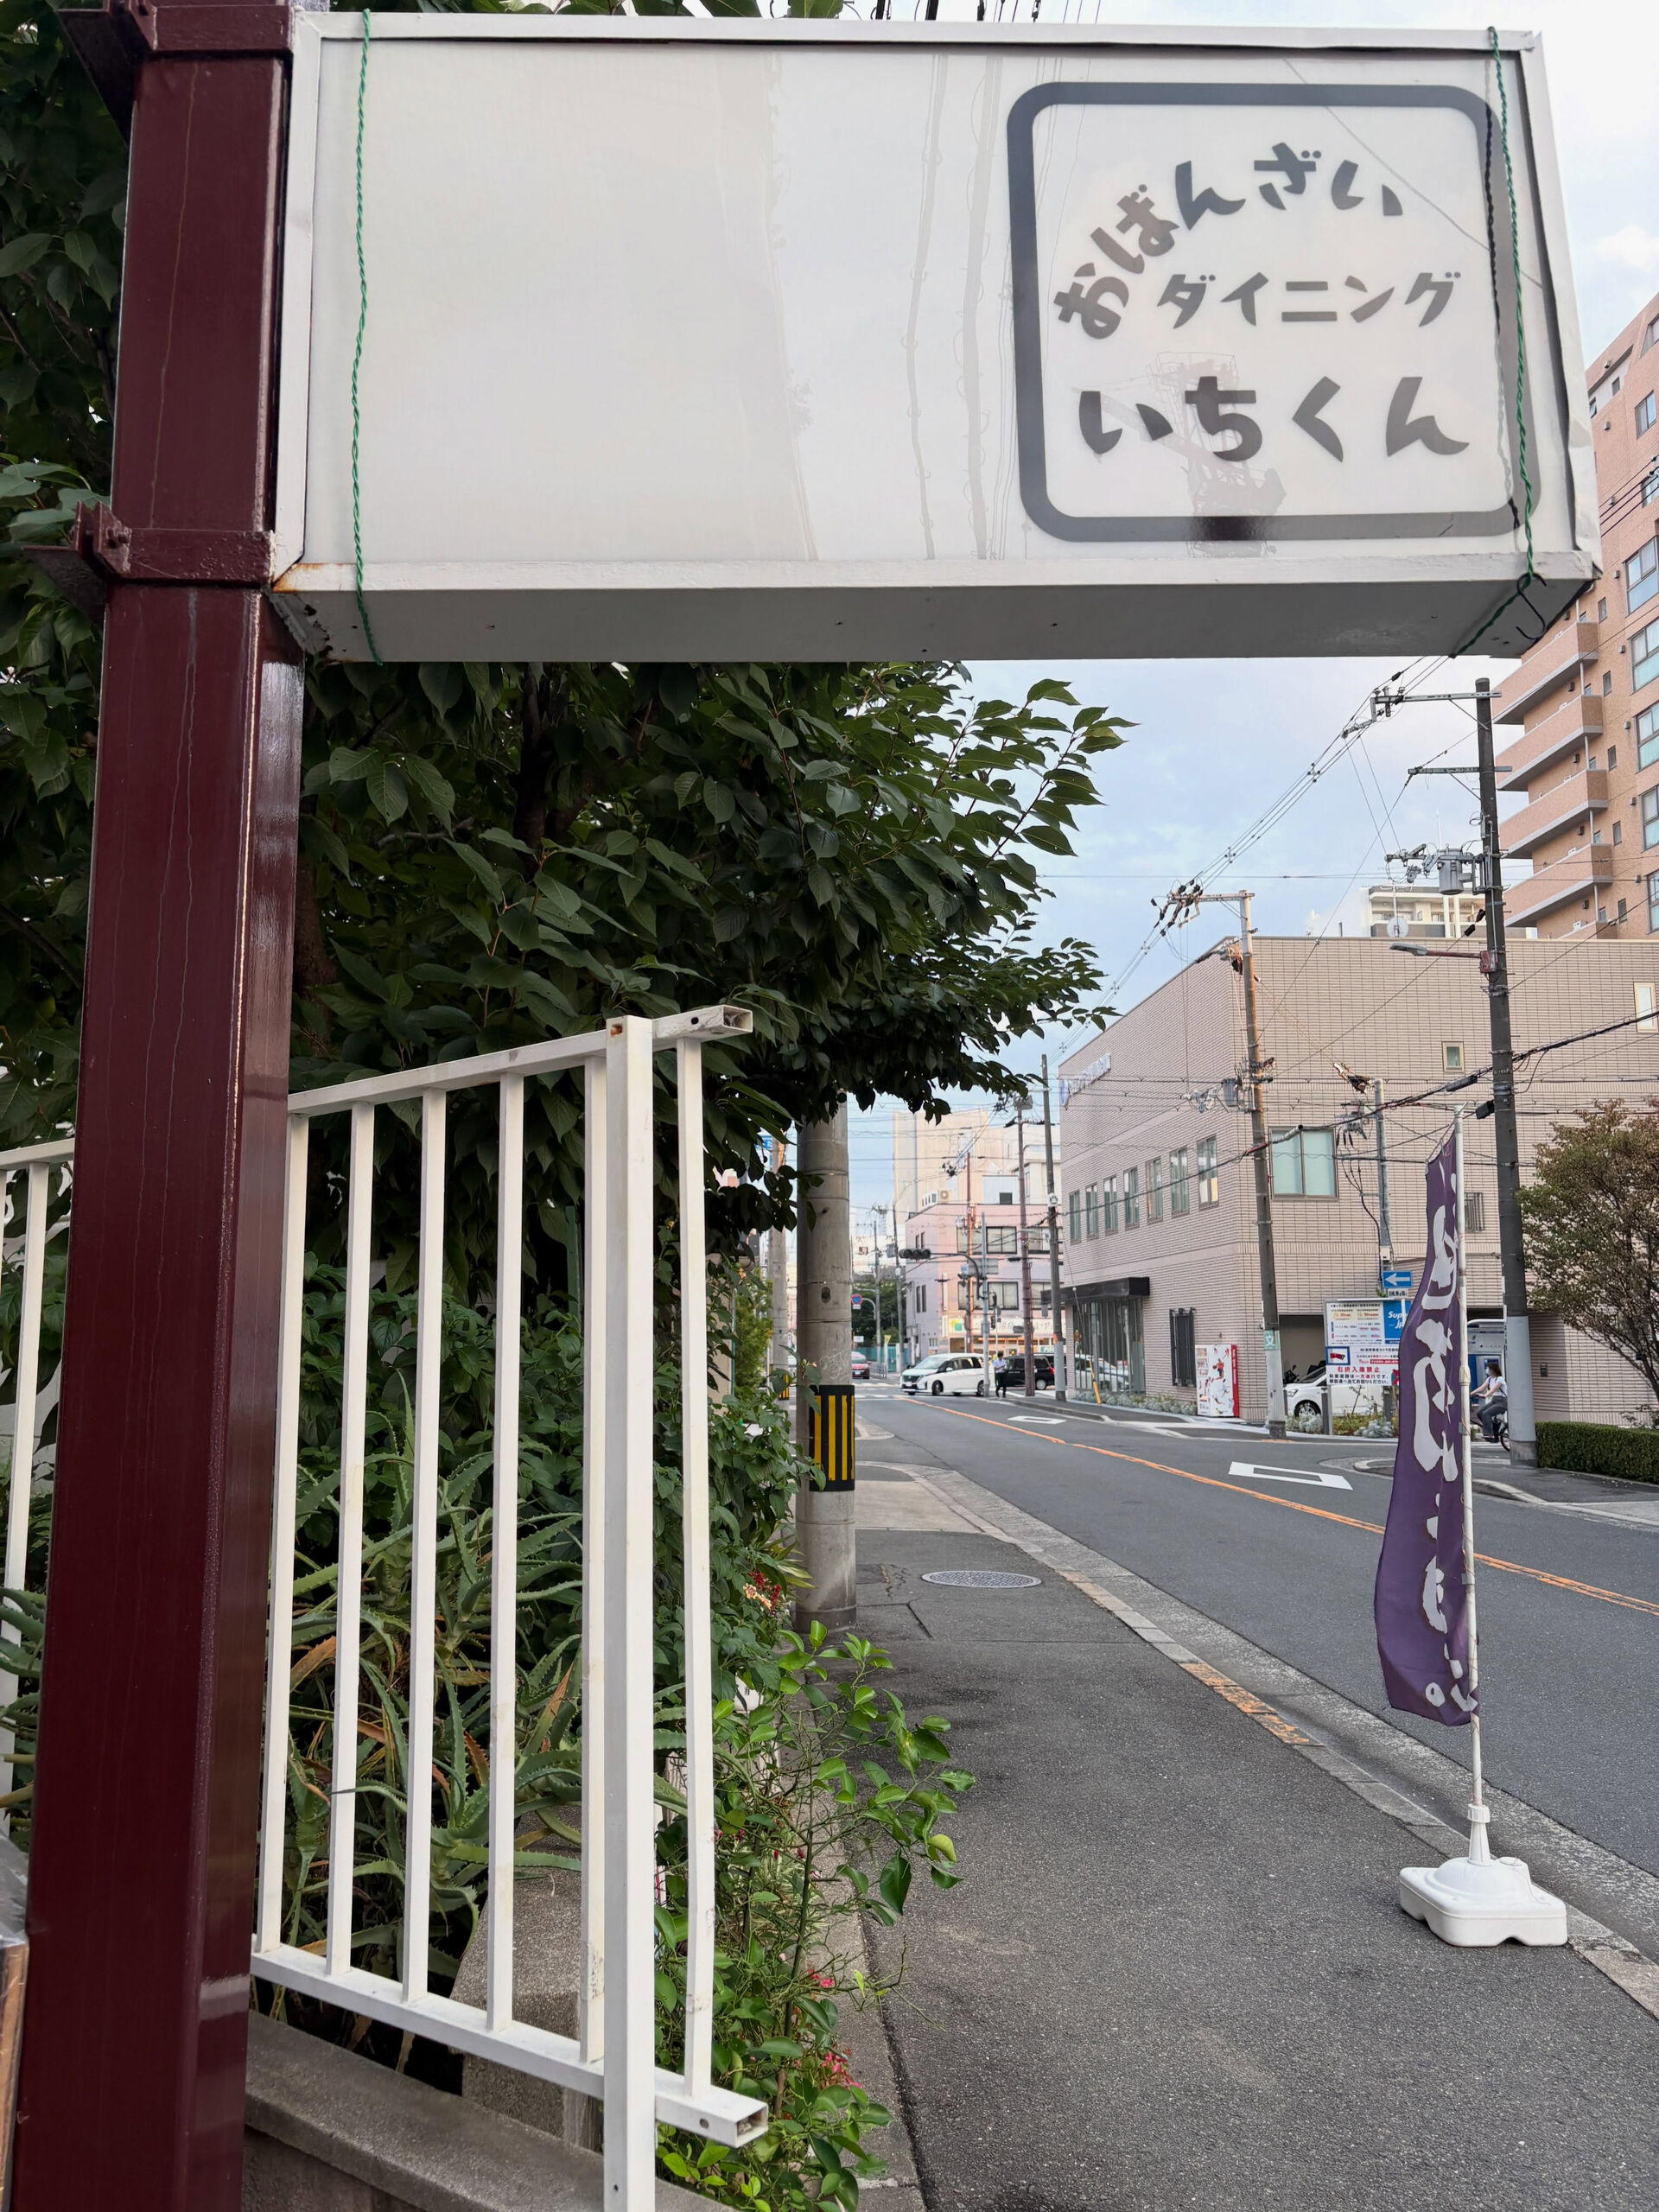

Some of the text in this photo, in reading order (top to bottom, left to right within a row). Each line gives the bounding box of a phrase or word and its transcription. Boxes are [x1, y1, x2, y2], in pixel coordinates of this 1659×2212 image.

[1054, 143, 1403, 340] おばんざい
[1157, 272, 1461, 329] ダイニング
[1079, 376, 1470, 462] いちくん
